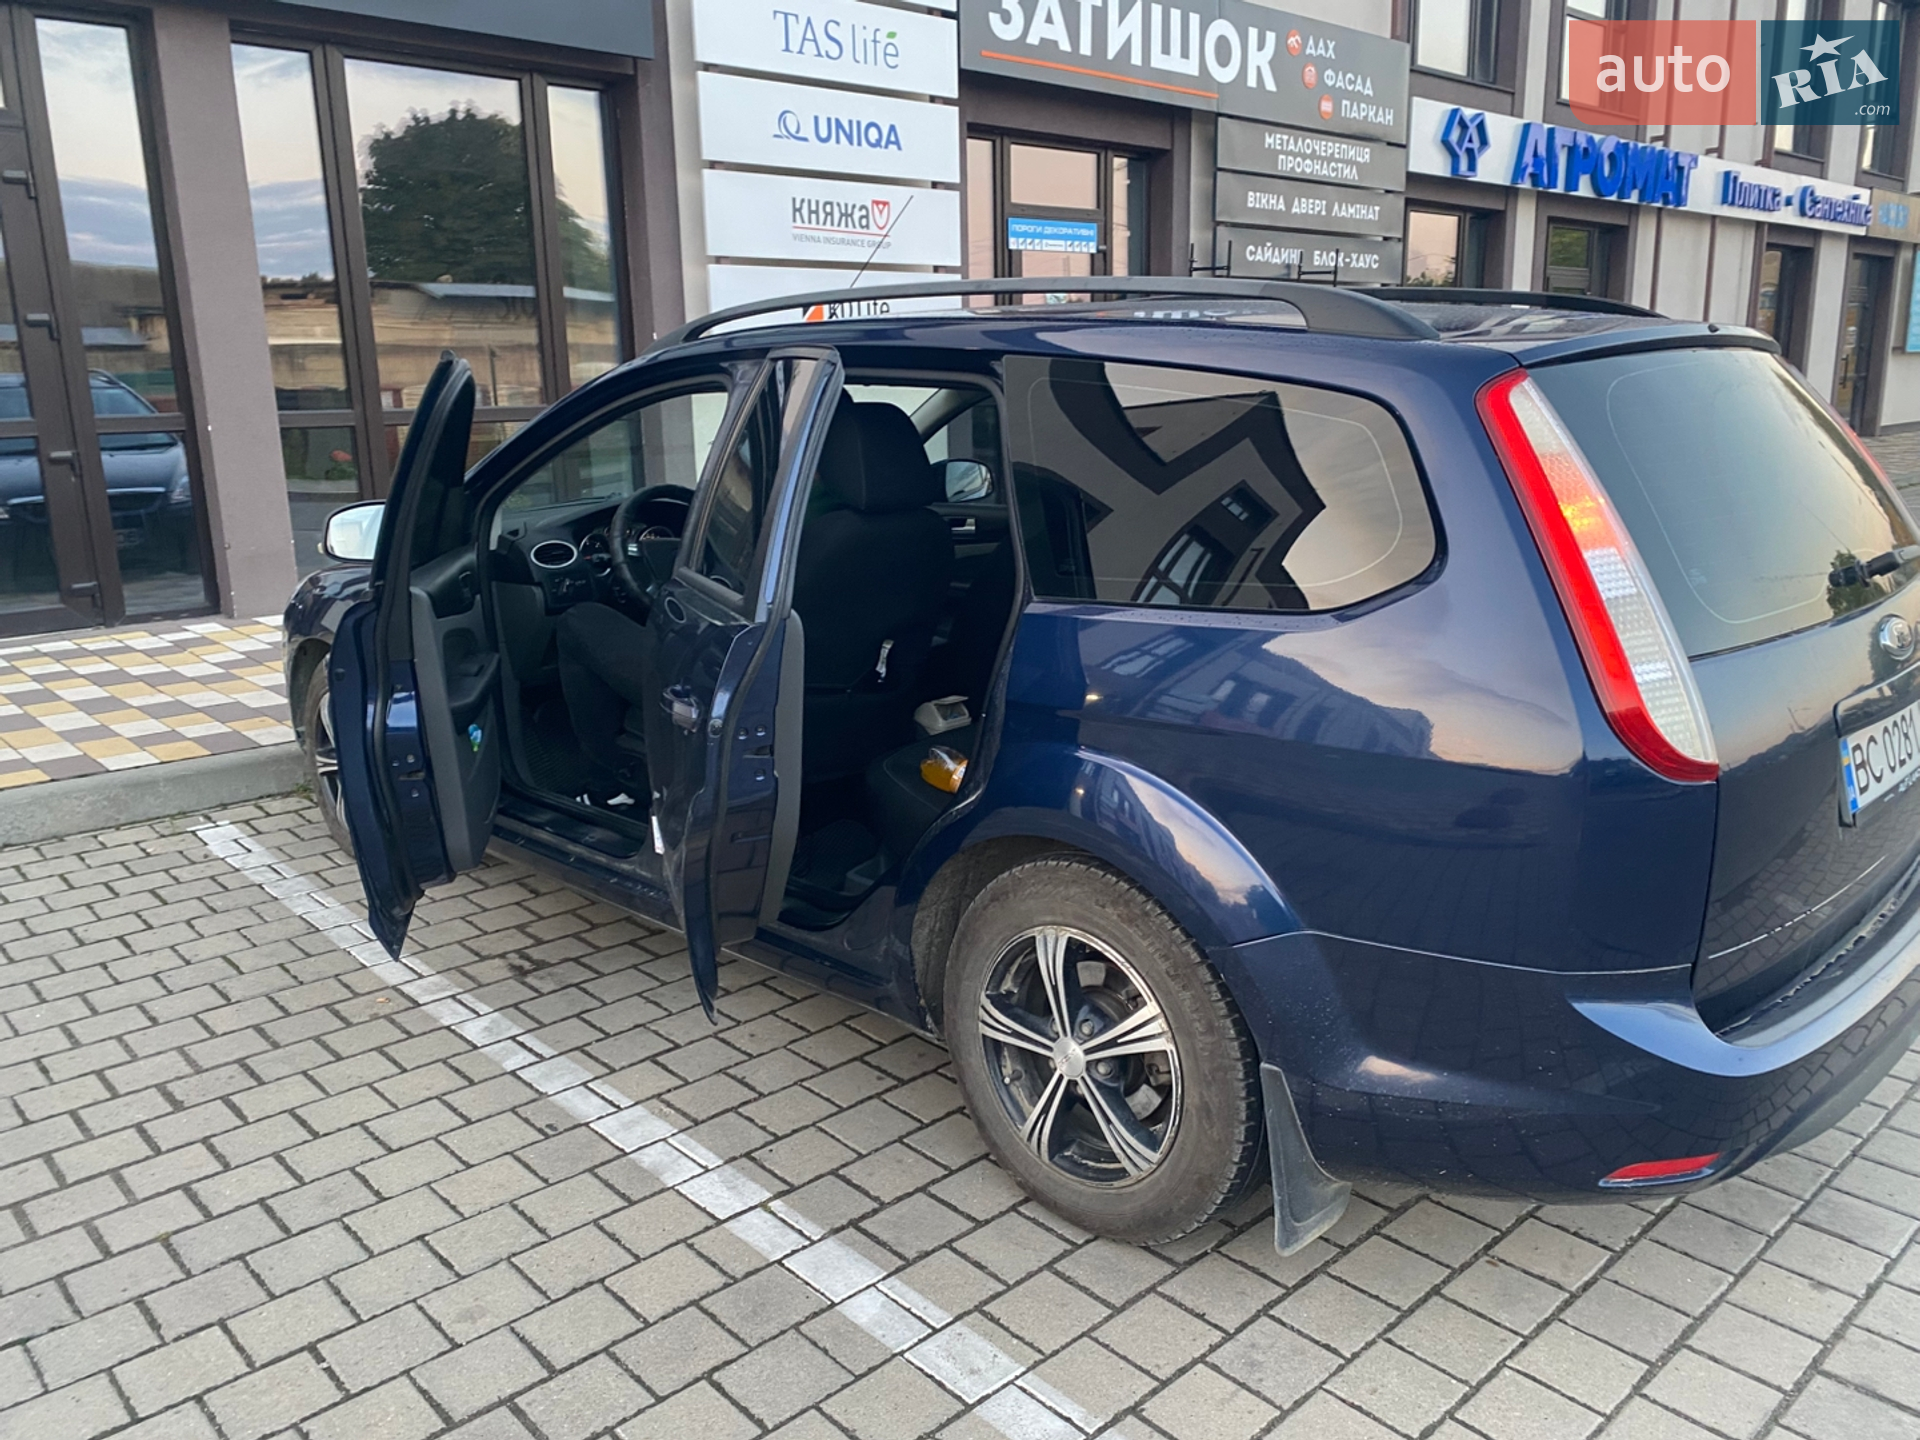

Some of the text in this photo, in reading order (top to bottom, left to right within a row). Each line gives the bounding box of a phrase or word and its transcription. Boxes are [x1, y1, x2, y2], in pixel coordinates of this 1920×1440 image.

[773, 10, 899, 69] TAS life
[988, 0, 1277, 92] ЗАТИШОК
[1305, 35, 1336, 59] ДАХ
[1323, 68, 1374, 97] ФАСАД
[1341, 99, 1394, 126] ПАРКАН
[813, 115, 903, 151] UNIQA
[1264, 132, 1370, 163] МЕТАЛОЧЕРЕПИЦЯ
[1278, 154, 1359, 180] ПРОФНАСТИЛ
[1511, 122, 1698, 207] АГРОМАТ
[1247, 191, 1380, 221] ВІКНА ДВЕРІ ЛАМІНАТ
[1722, 170, 1782, 212] Плитка
[1799, 184, 1873, 227] Сантехніка
[792, 233, 892, 250] VIENNA INSURANCE GROUP
[1011, 224, 1042, 233] ПОРОГИ
[1314, 250, 1380, 268] БЛОК-ХАУС
[1851, 734, 1884, 796] BC
[1882, 707, 1920, 774] 0281
